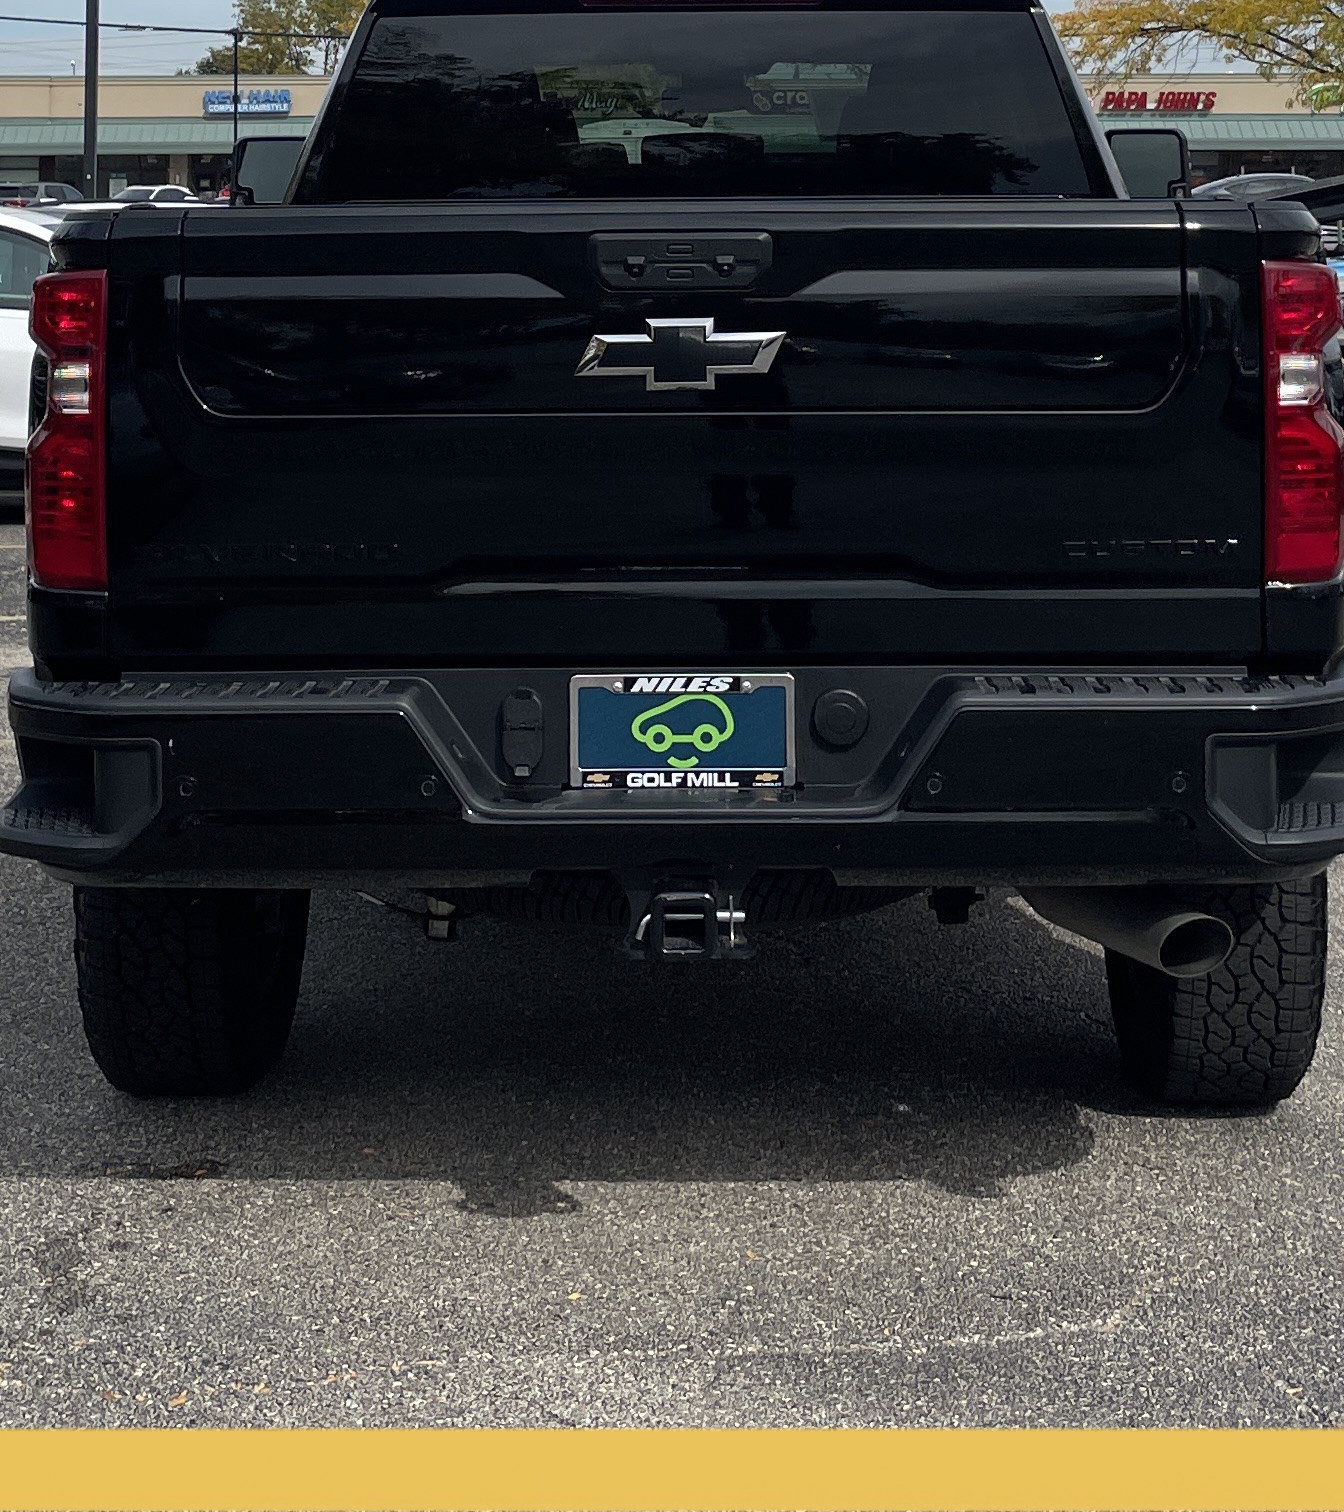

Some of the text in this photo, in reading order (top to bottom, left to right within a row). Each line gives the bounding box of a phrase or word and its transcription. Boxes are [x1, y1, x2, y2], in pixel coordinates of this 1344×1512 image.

[1100, 91, 1148, 112] PAPA
[630, 677, 734, 692] NILES
[626, 772, 739, 787] GOLF MILL
